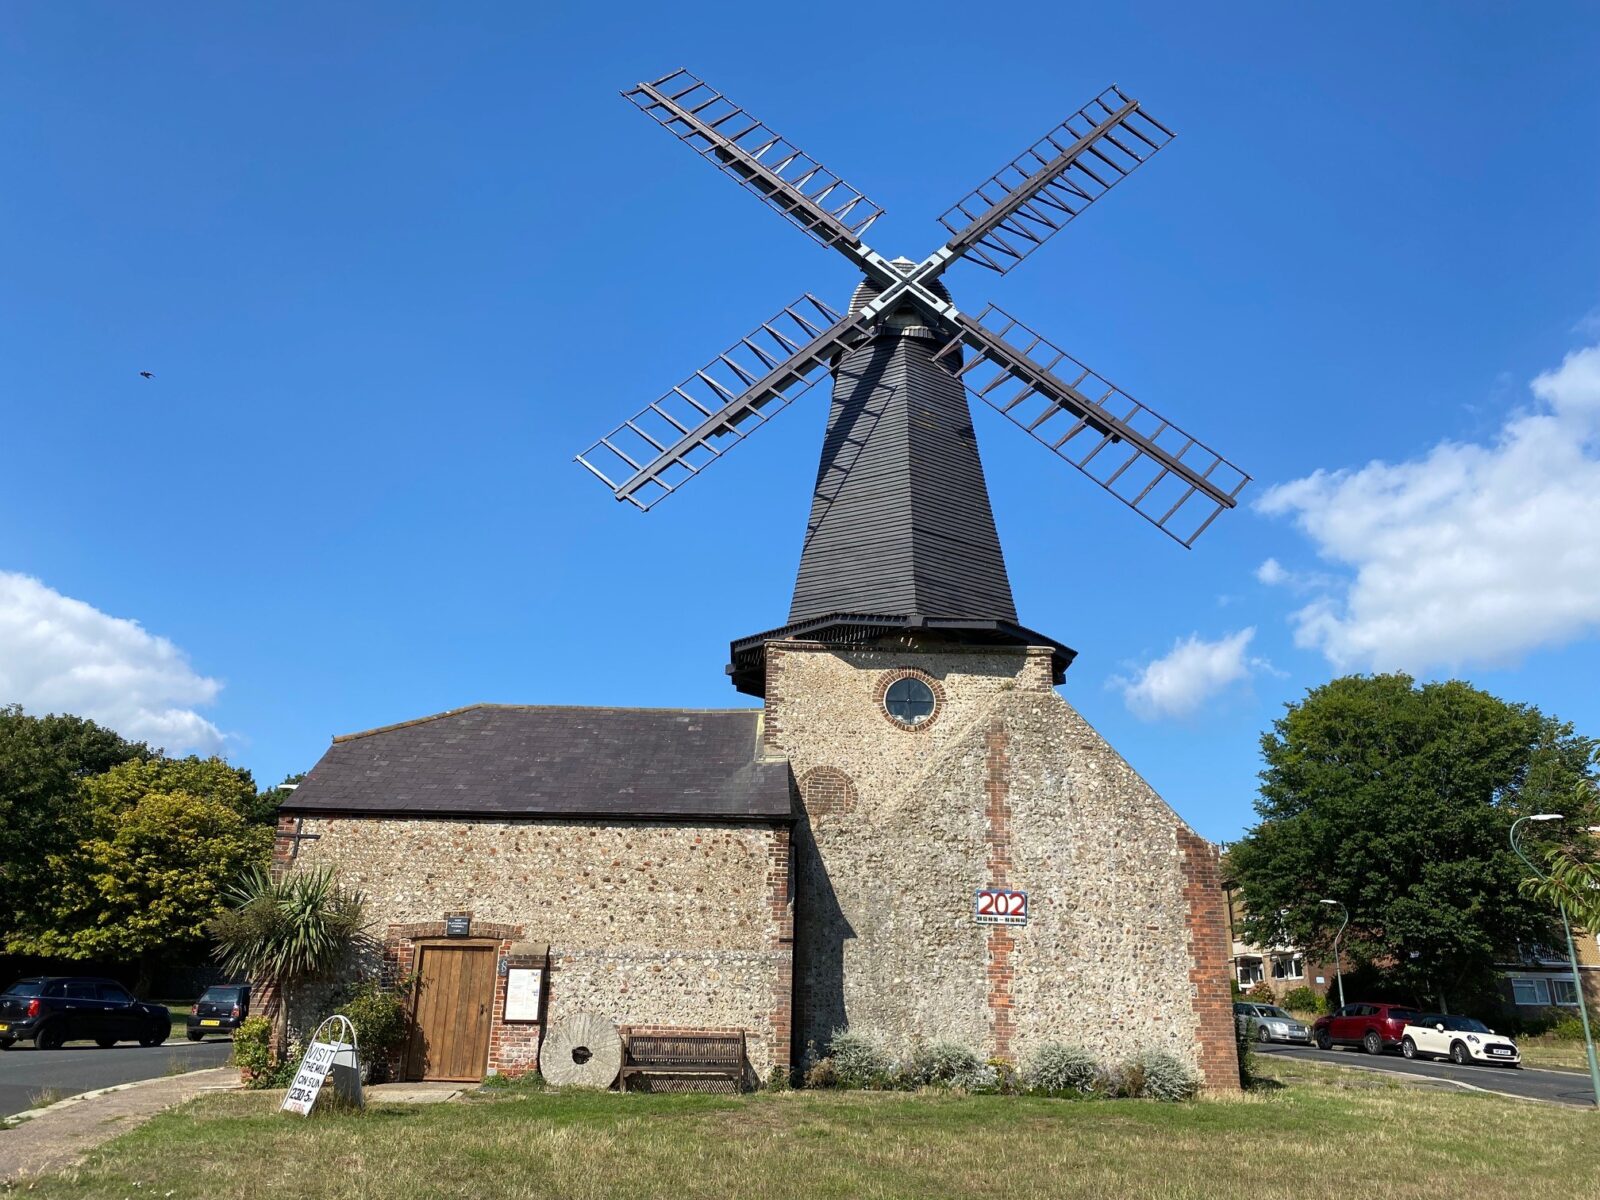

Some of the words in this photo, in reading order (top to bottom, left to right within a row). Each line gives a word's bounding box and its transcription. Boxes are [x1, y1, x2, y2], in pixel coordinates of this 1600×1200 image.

[978, 891, 1025, 916] 202
[308, 1046, 335, 1064] VISIT
[304, 1061, 315, 1072] THE
[314, 1063, 328, 1075] MILL
[298, 1075, 308, 1086] ON
[307, 1077, 320, 1088] SUN
